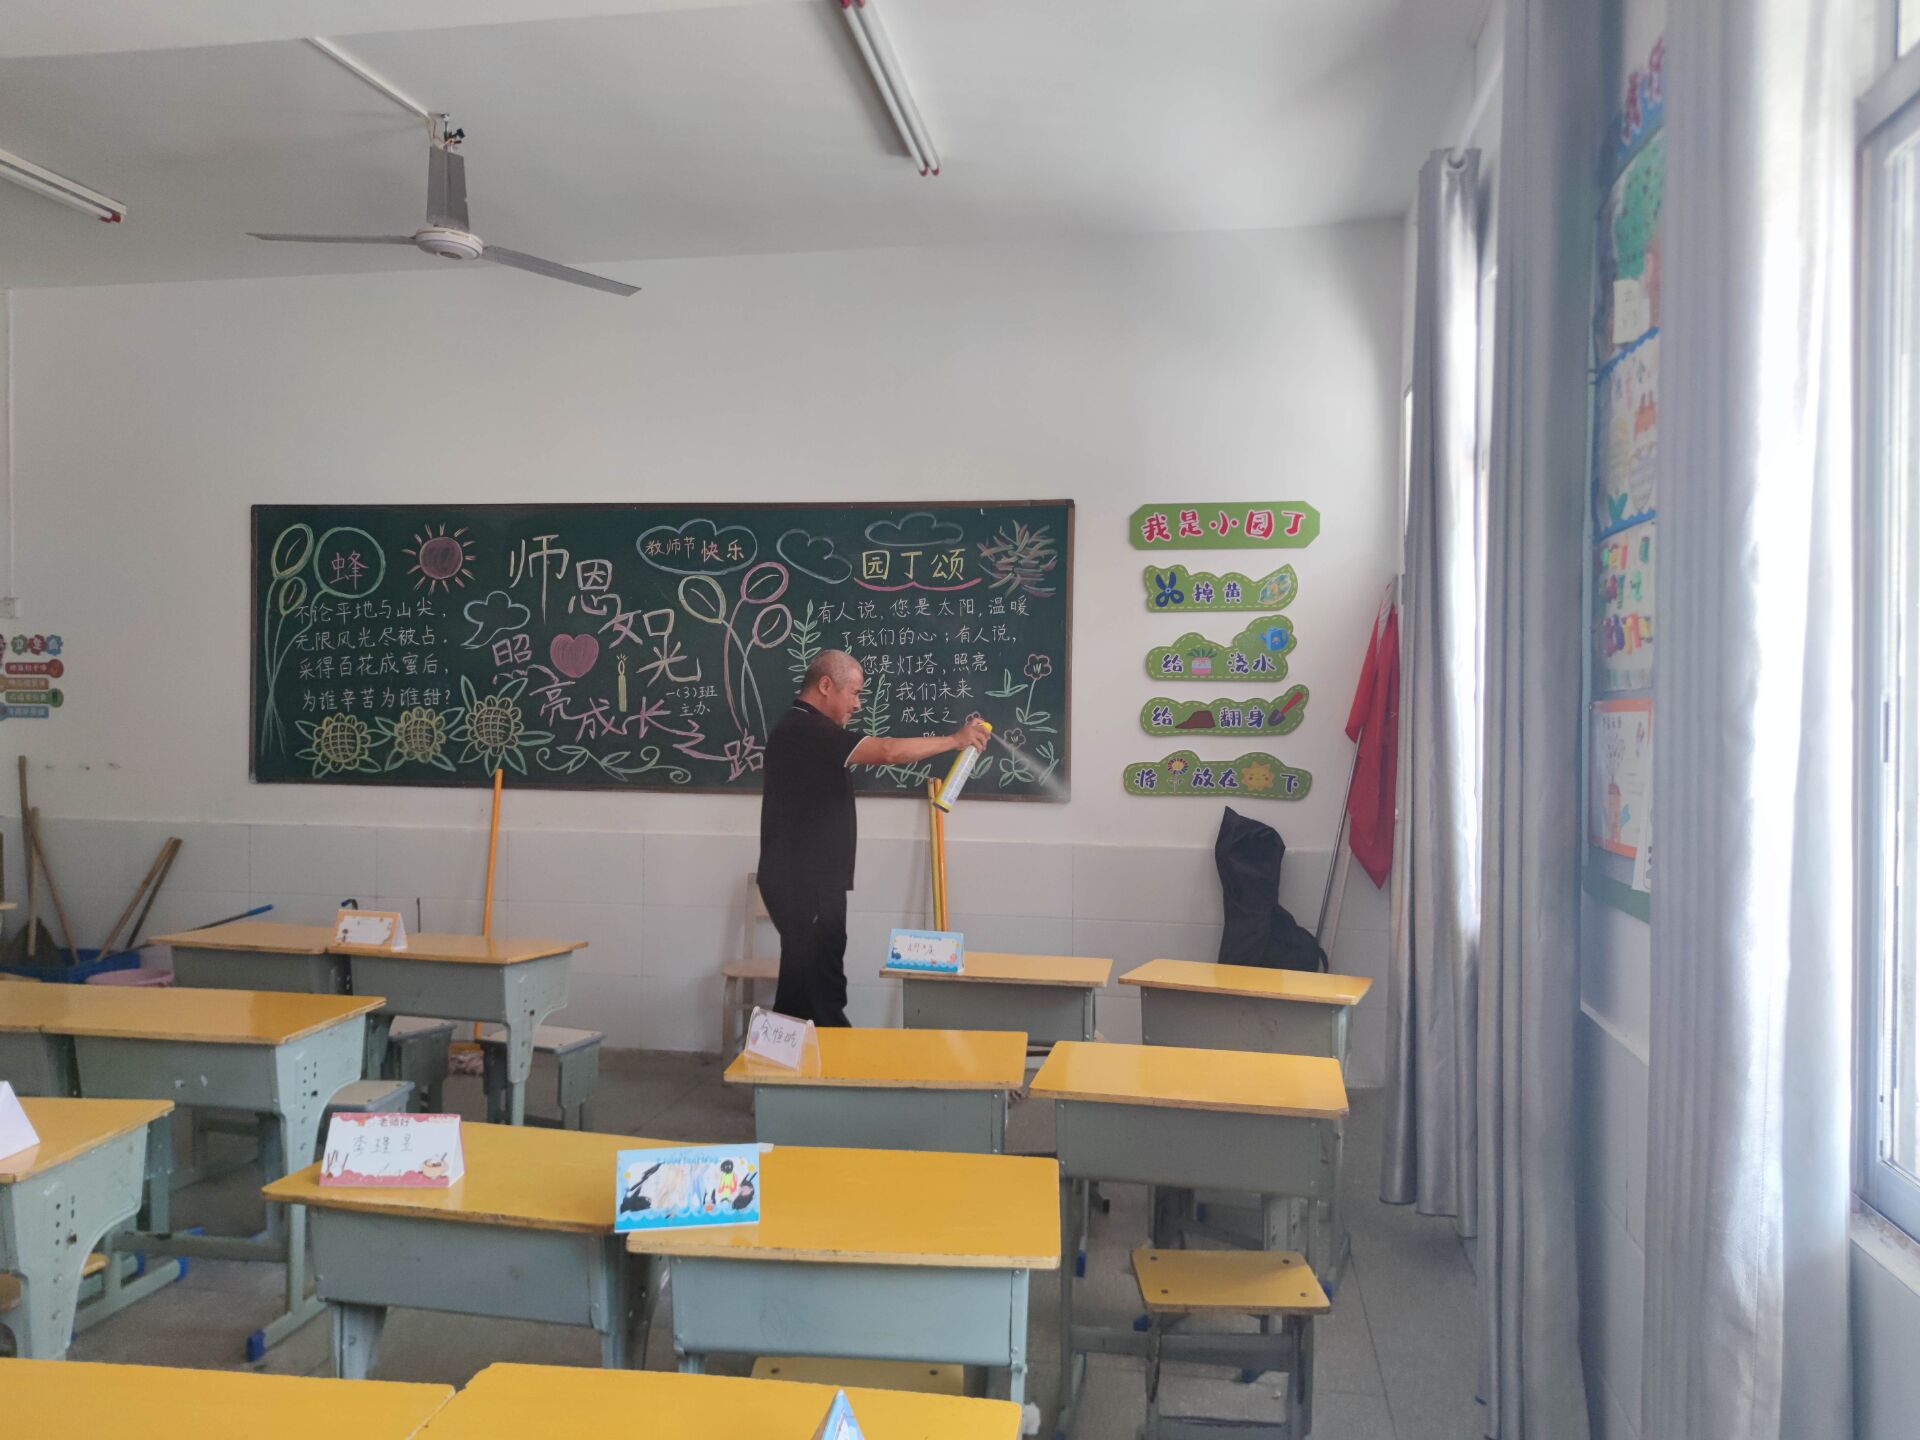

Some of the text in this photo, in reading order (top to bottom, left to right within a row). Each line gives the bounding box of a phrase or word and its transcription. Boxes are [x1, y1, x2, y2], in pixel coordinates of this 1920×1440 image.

[1141, 509, 1306, 542] 我是小园丁
[645, 537, 746, 562] 教师节快乐
[330, 550, 369, 590] 蜂
[862, 548, 966, 580] 园丁颂
[1162, 653, 1276, 674] 给 浇水
[680, 701, 711, 717] 主办
[901, 706, 958, 723] 成长之
[1152, 707, 1265, 728] 给 翻身
[1135, 768, 1299, 793] 将 放在 下
